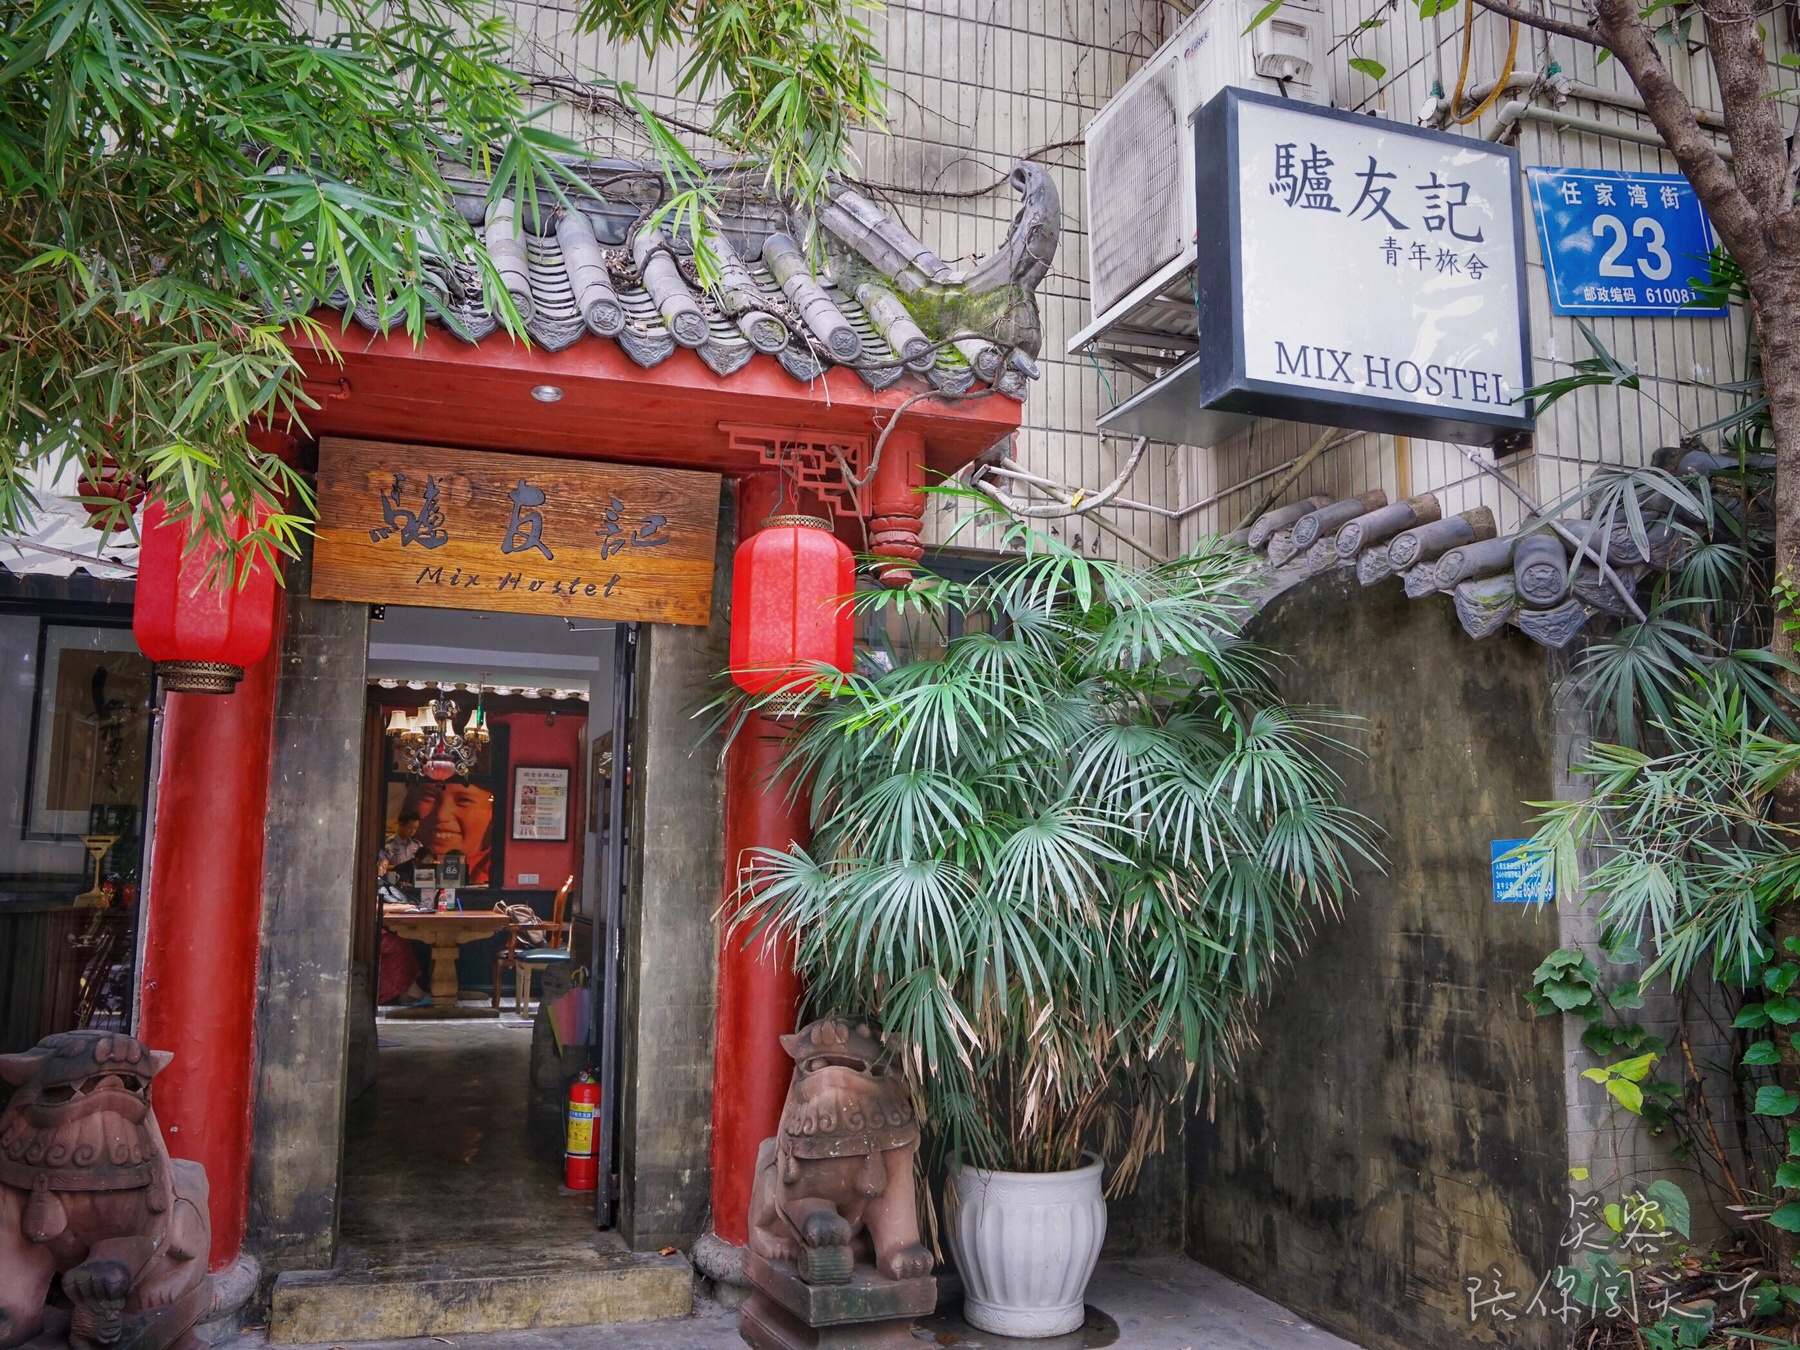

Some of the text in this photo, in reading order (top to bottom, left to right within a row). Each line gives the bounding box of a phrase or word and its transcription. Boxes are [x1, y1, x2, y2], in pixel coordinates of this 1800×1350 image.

[1190, 28, 1210, 53] GREE
[1269, 142, 1484, 243] 驢友記
[1560, 180, 1681, 210] 任家湾街
[1379, 236, 1490, 281] 青年旅舍
[1592, 214, 1673, 281] 23
[1583, 286, 1637, 304] 邮政编码
[1274, 341, 1514, 407] MIX HOSTEL
[416, 566, 623, 599] Mix Hostel
